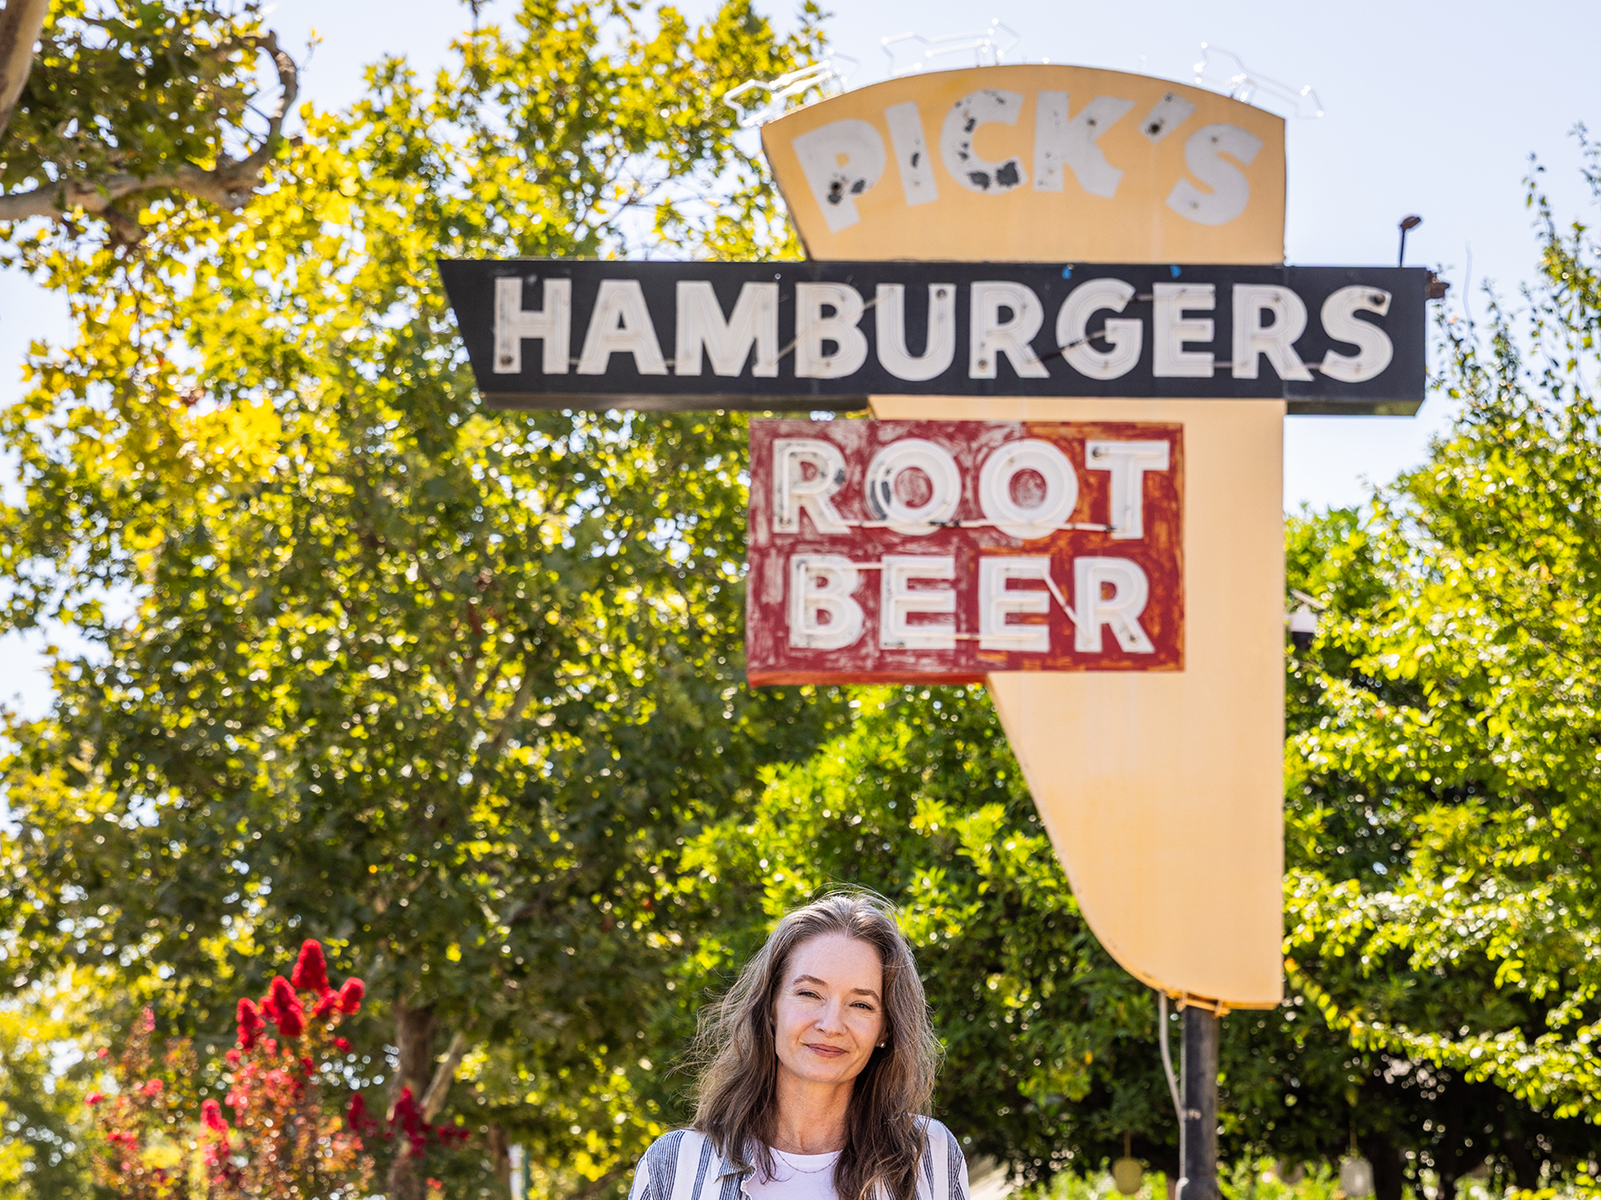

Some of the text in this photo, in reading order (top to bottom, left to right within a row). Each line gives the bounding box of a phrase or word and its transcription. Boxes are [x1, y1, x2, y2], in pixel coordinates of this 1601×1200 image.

[792, 88, 1264, 234] PICK'S
[493, 277, 1395, 384] HAMBURGERS
[772, 438, 1171, 541] ROOT
[789, 553, 1156, 654] BEER
